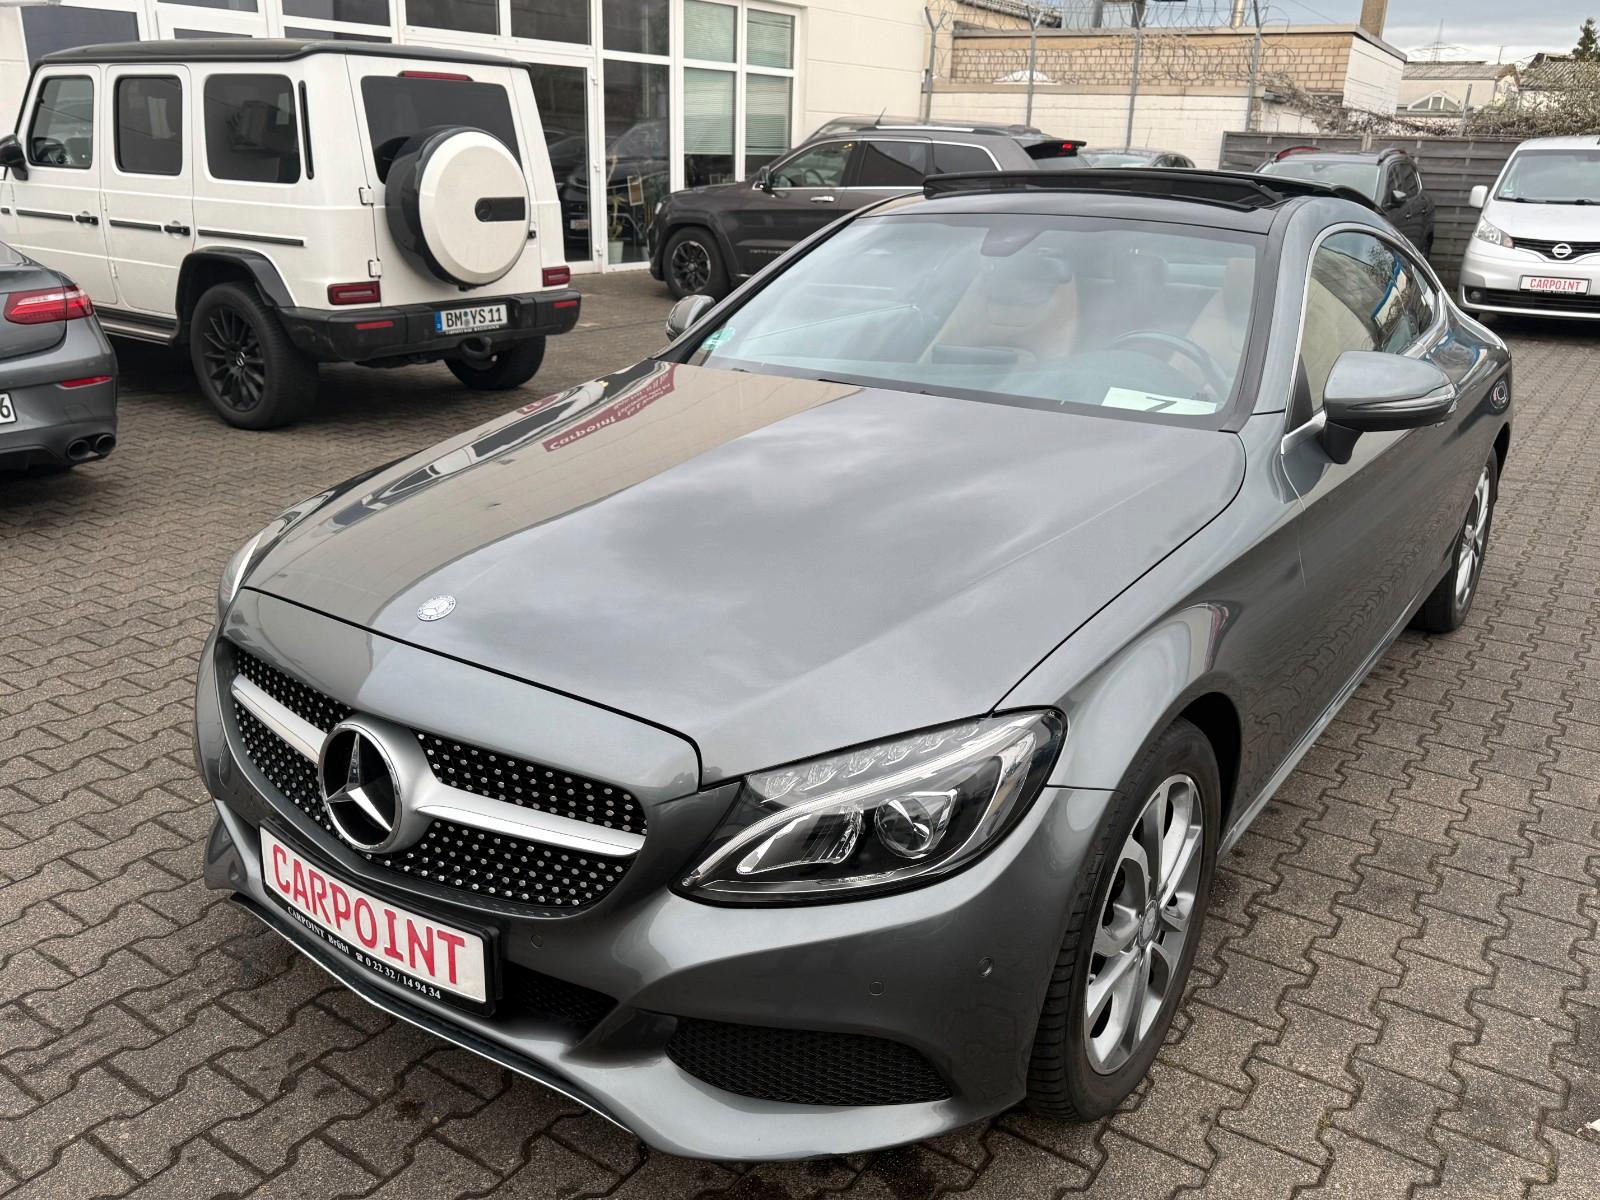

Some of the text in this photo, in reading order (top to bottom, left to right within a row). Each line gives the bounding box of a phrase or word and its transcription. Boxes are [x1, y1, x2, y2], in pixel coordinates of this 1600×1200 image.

[1530, 279, 1581, 291] CARPOINT
[446, 312, 463, 328] BM
[272, 844, 466, 985] CARPOINT
[287, 907, 325, 937] CARPOINT
[328, 936, 349, 954] Brühl
[373, 961, 384, 973] 22
[384, 967, 395, 979] 32
[402, 976, 414, 988] 14
[415, 981, 427, 994] 94
[428, 988, 441, 1000] 34
